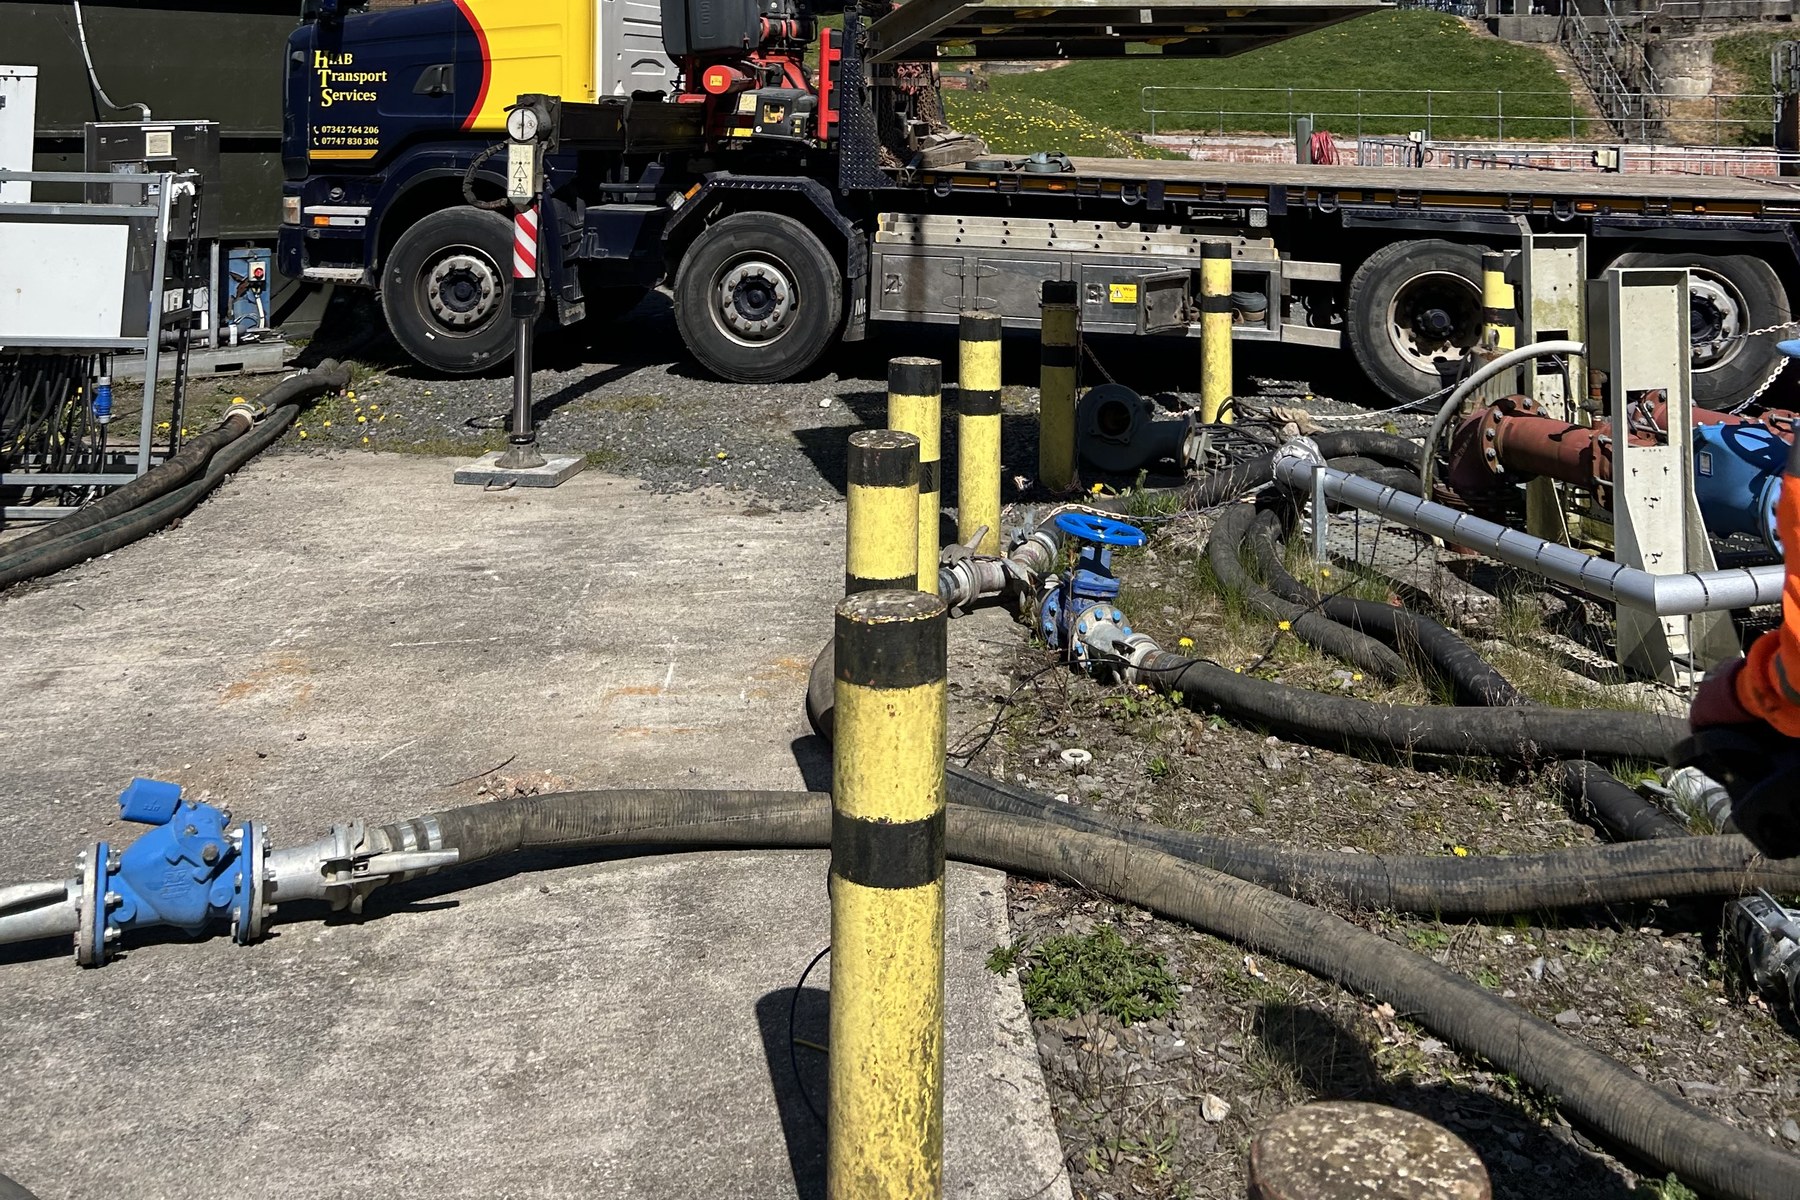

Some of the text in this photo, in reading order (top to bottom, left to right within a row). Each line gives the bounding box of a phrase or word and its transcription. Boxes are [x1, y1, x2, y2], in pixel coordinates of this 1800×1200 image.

[317, 69, 387, 88] Transport
[320, 88, 377, 108] Services
[321, 125, 380, 134] 07342 764 206
[321, 137, 380, 145] 07747 830 306
